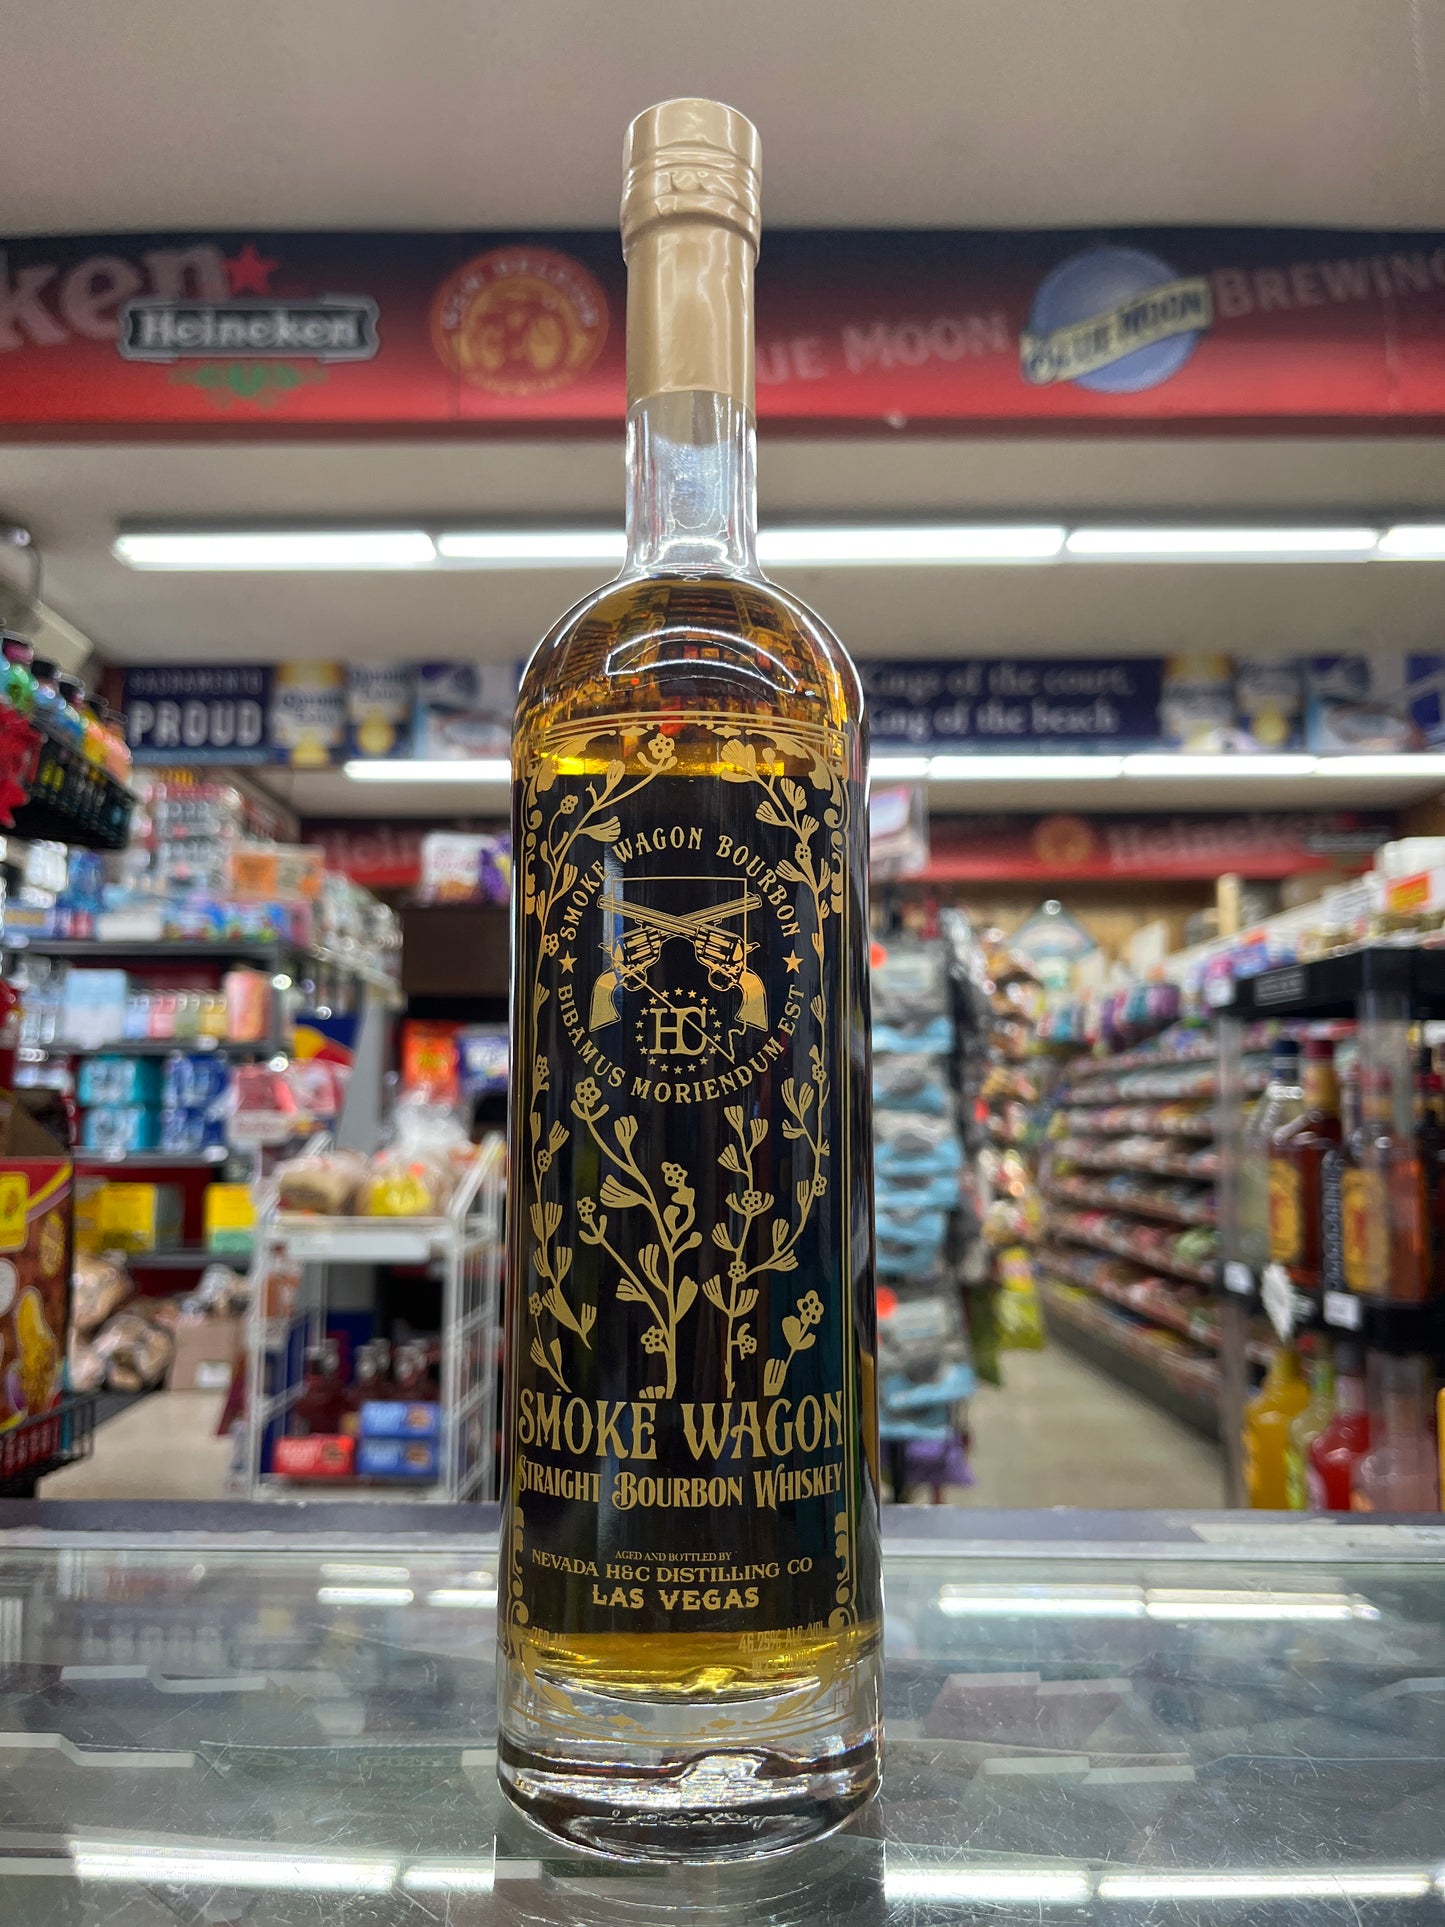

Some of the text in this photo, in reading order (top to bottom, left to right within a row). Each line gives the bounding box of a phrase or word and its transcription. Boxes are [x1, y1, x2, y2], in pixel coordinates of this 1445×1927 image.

[140, 309, 361, 348] Heineken
[1115, 289, 1202, 341] MOON
[841, 312, 1009, 374] MOON
[947, 662, 986, 696] of
[988, 662, 1042, 696] the
[127, 700, 264, 748] PROUD
[933, 696, 972, 734] of
[976, 697, 1029, 734] the
[1031, 697, 1120, 734] beach
[560, 826, 800, 941] SMOKE WAGON BOURBON
[558, 983, 626, 1087] BIBAMUS
[630, 1036, 785, 1104] MORIENDUM
[777, 984, 805, 1037] EST
[518, 1387, 844, 1461] SMOKE WAGON
[518, 1454, 843, 1511] STRAIGHT BOURBON WHISKEY
[531, 1548, 814, 1583] NEVADA H&C DISTILLING CO
[615, 1550, 733, 1562] AGED AND BOTTLED BY
[592, 1583, 760, 1611] LAS VEGAS
